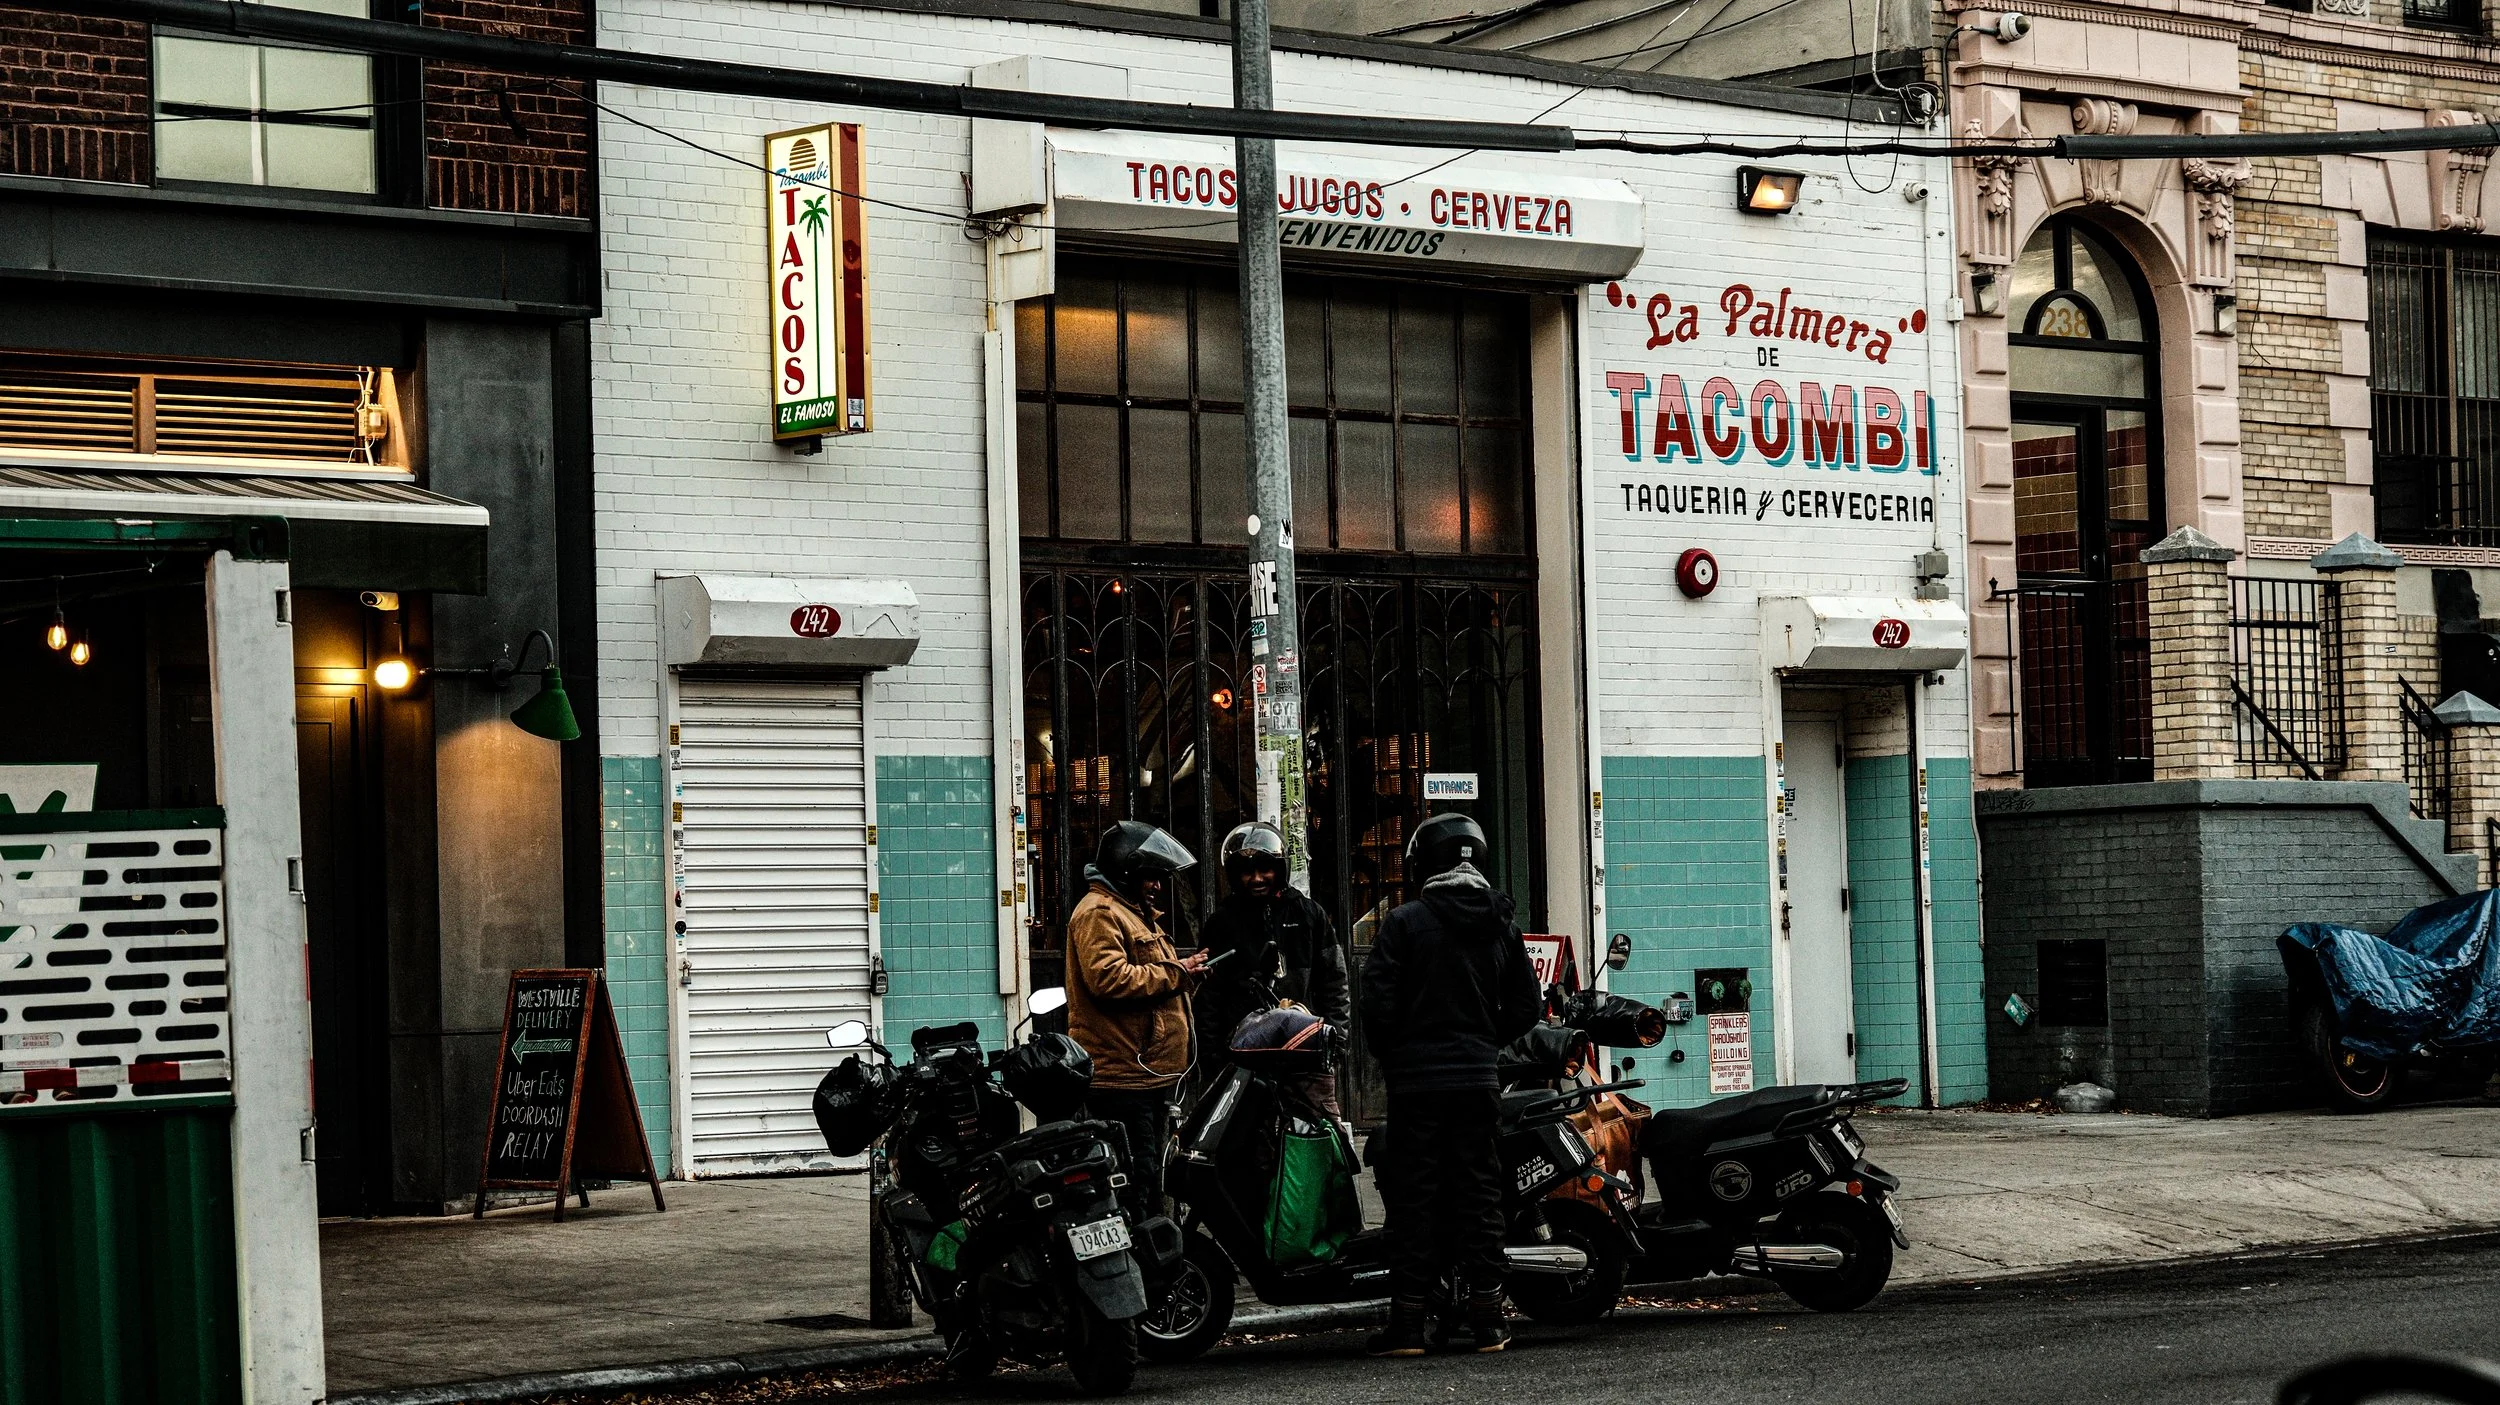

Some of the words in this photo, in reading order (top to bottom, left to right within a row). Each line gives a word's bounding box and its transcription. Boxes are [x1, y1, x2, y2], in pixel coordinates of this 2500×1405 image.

[775, 162, 829, 188] Tacombi
[1126, 161, 1237, 206] TACOS
[1278, 174, 1384, 221] JUGOS
[1430, 187, 1574, 237] CERVEZA
[1279, 220, 1445, 256] ENVENIDOS
[780, 187, 805, 395] TACOS
[1646, 292, 1699, 350] La
[1720, 284, 1892, 364] Palmera
[2042, 307, 2090, 338] 238
[1758, 346, 1779, 367] DE
[781, 406, 794, 424] EL
[794, 401, 834, 422] FAMOSO
[1606, 371, 1938, 476] TACOMBI
[1621, 483, 1747, 516] TAQUERIA
[1755, 490, 1774, 522] y
[1782, 490, 1934, 523] CERVECERIA
[799, 606, 830, 634] 242
[1880, 622, 1902, 645] 242
[1428, 781, 1474, 795] ENTRANCE
[1710, 1017, 1748, 1029] SPRINKLERS
[1711, 1033, 1748, 1044] THROUGHOUT
[1713, 1048, 1748, 1059] BUILDING
[1732, 1063, 1752, 1071] SPRINKLER
[507, 1072, 537, 1098] Uber
[538, 1070, 565, 1097] Eats
[502, 1105, 563, 1128] DOORDASH
[500, 1132, 554, 1159] RELAY
[1516, 1163, 1554, 1191] UFO
[1775, 1173, 1812, 1198] UFO
[1079, 1227, 1122, 1253] 194CA3
